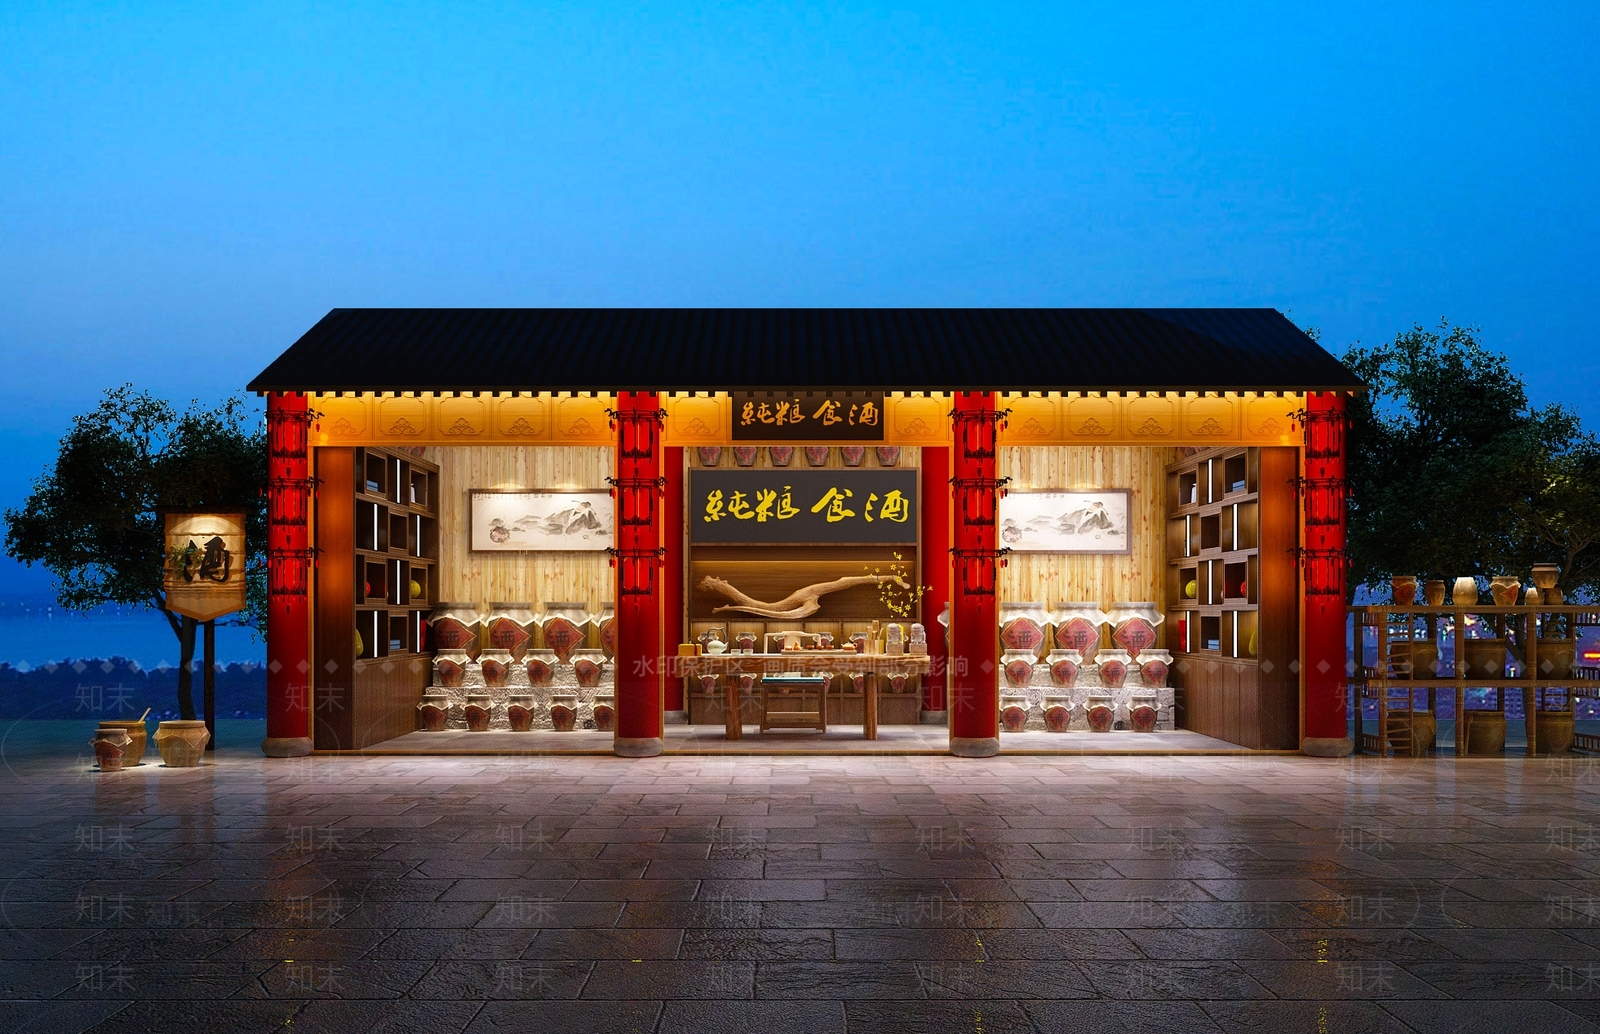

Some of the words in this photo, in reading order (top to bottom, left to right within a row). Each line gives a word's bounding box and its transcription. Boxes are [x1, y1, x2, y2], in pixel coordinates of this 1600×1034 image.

[548, 629, 570, 648] 酒
[1008, 629, 1032, 648] 酒
[1064, 629, 1088, 648] 酒
[1121, 629, 1145, 648] 酒
